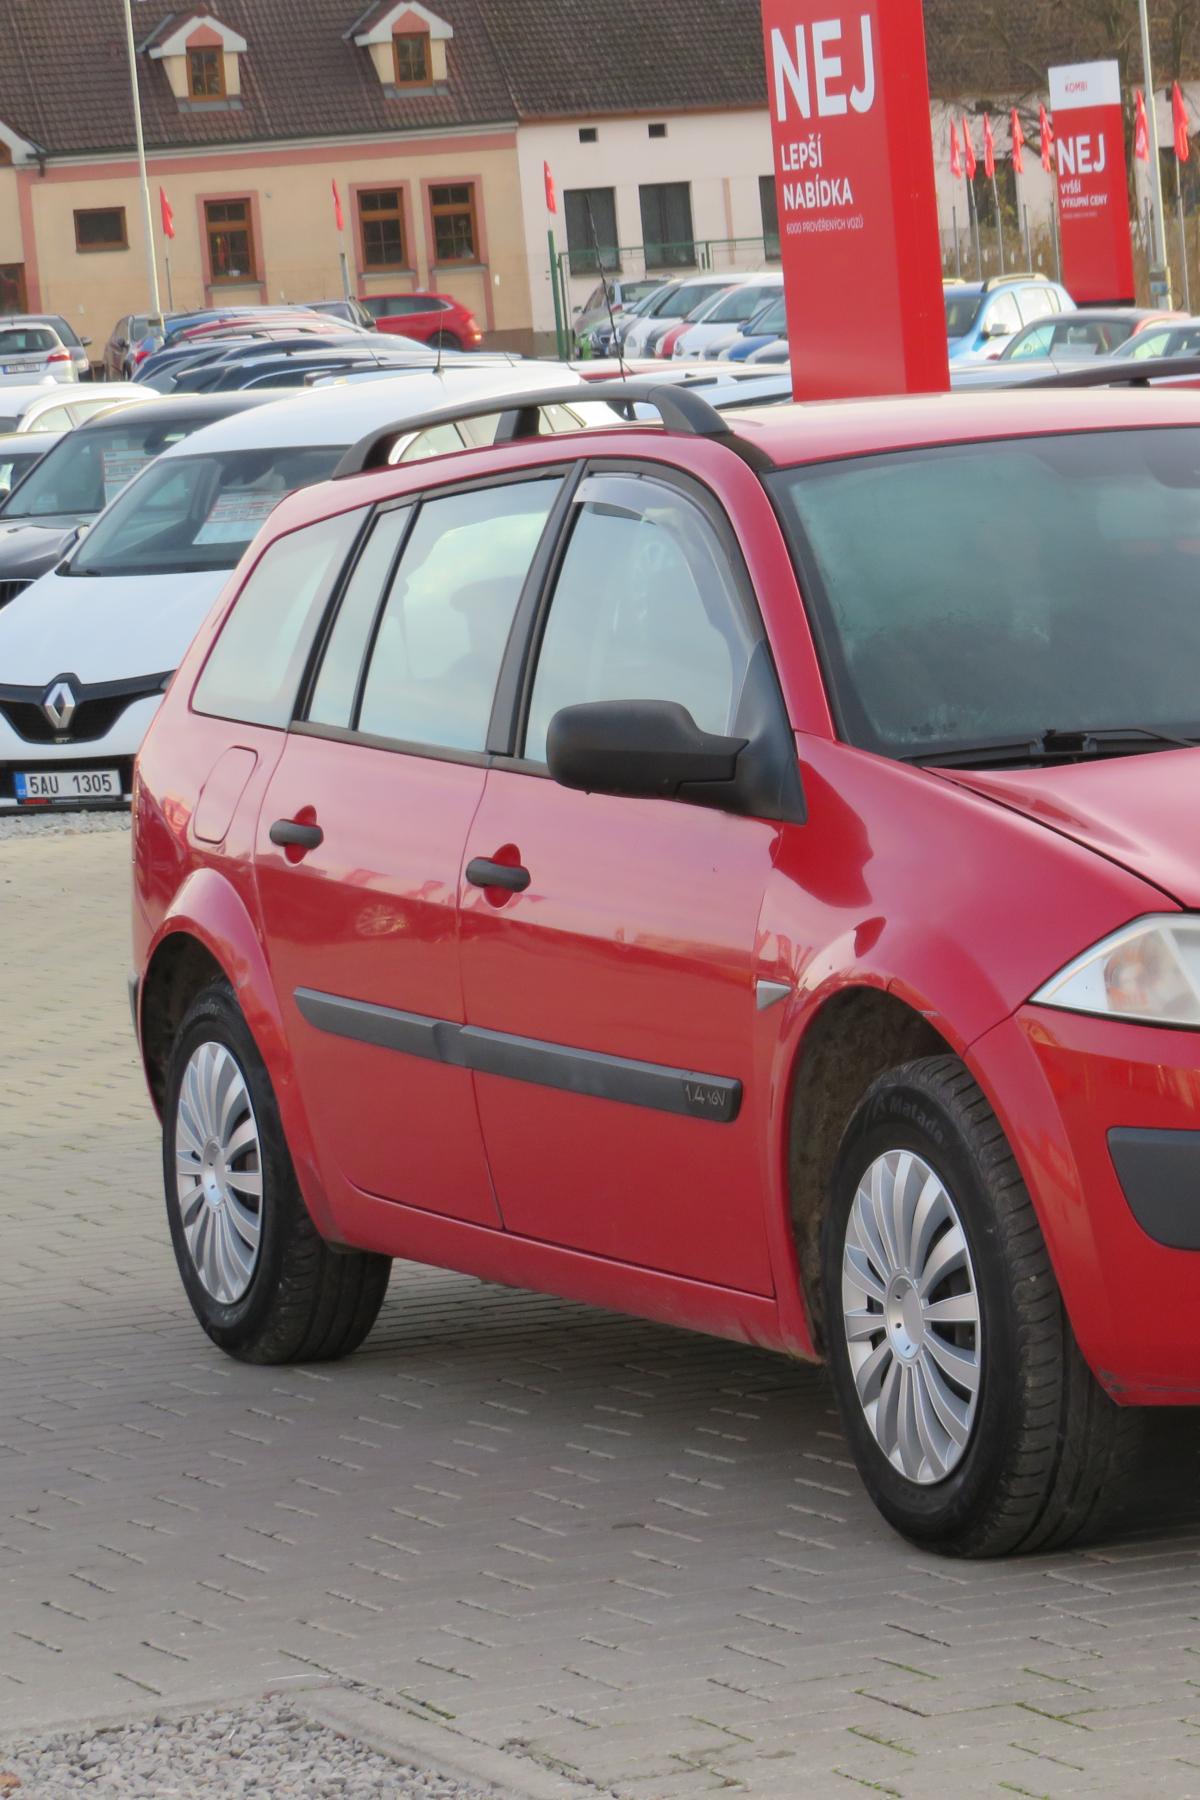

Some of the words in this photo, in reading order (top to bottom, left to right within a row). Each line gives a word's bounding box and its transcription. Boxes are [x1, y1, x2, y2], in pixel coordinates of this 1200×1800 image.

[770, 14, 875, 122] NEJ
[780, 134, 823, 171] LEPŠÍ
[1056, 133, 1106, 176] NEJ
[783, 174, 853, 211] NABÍDKA
[29, 775, 60, 795] 5AU
[72, 773, 113, 794] 1305
[889, 1095, 946, 1146] Matado
